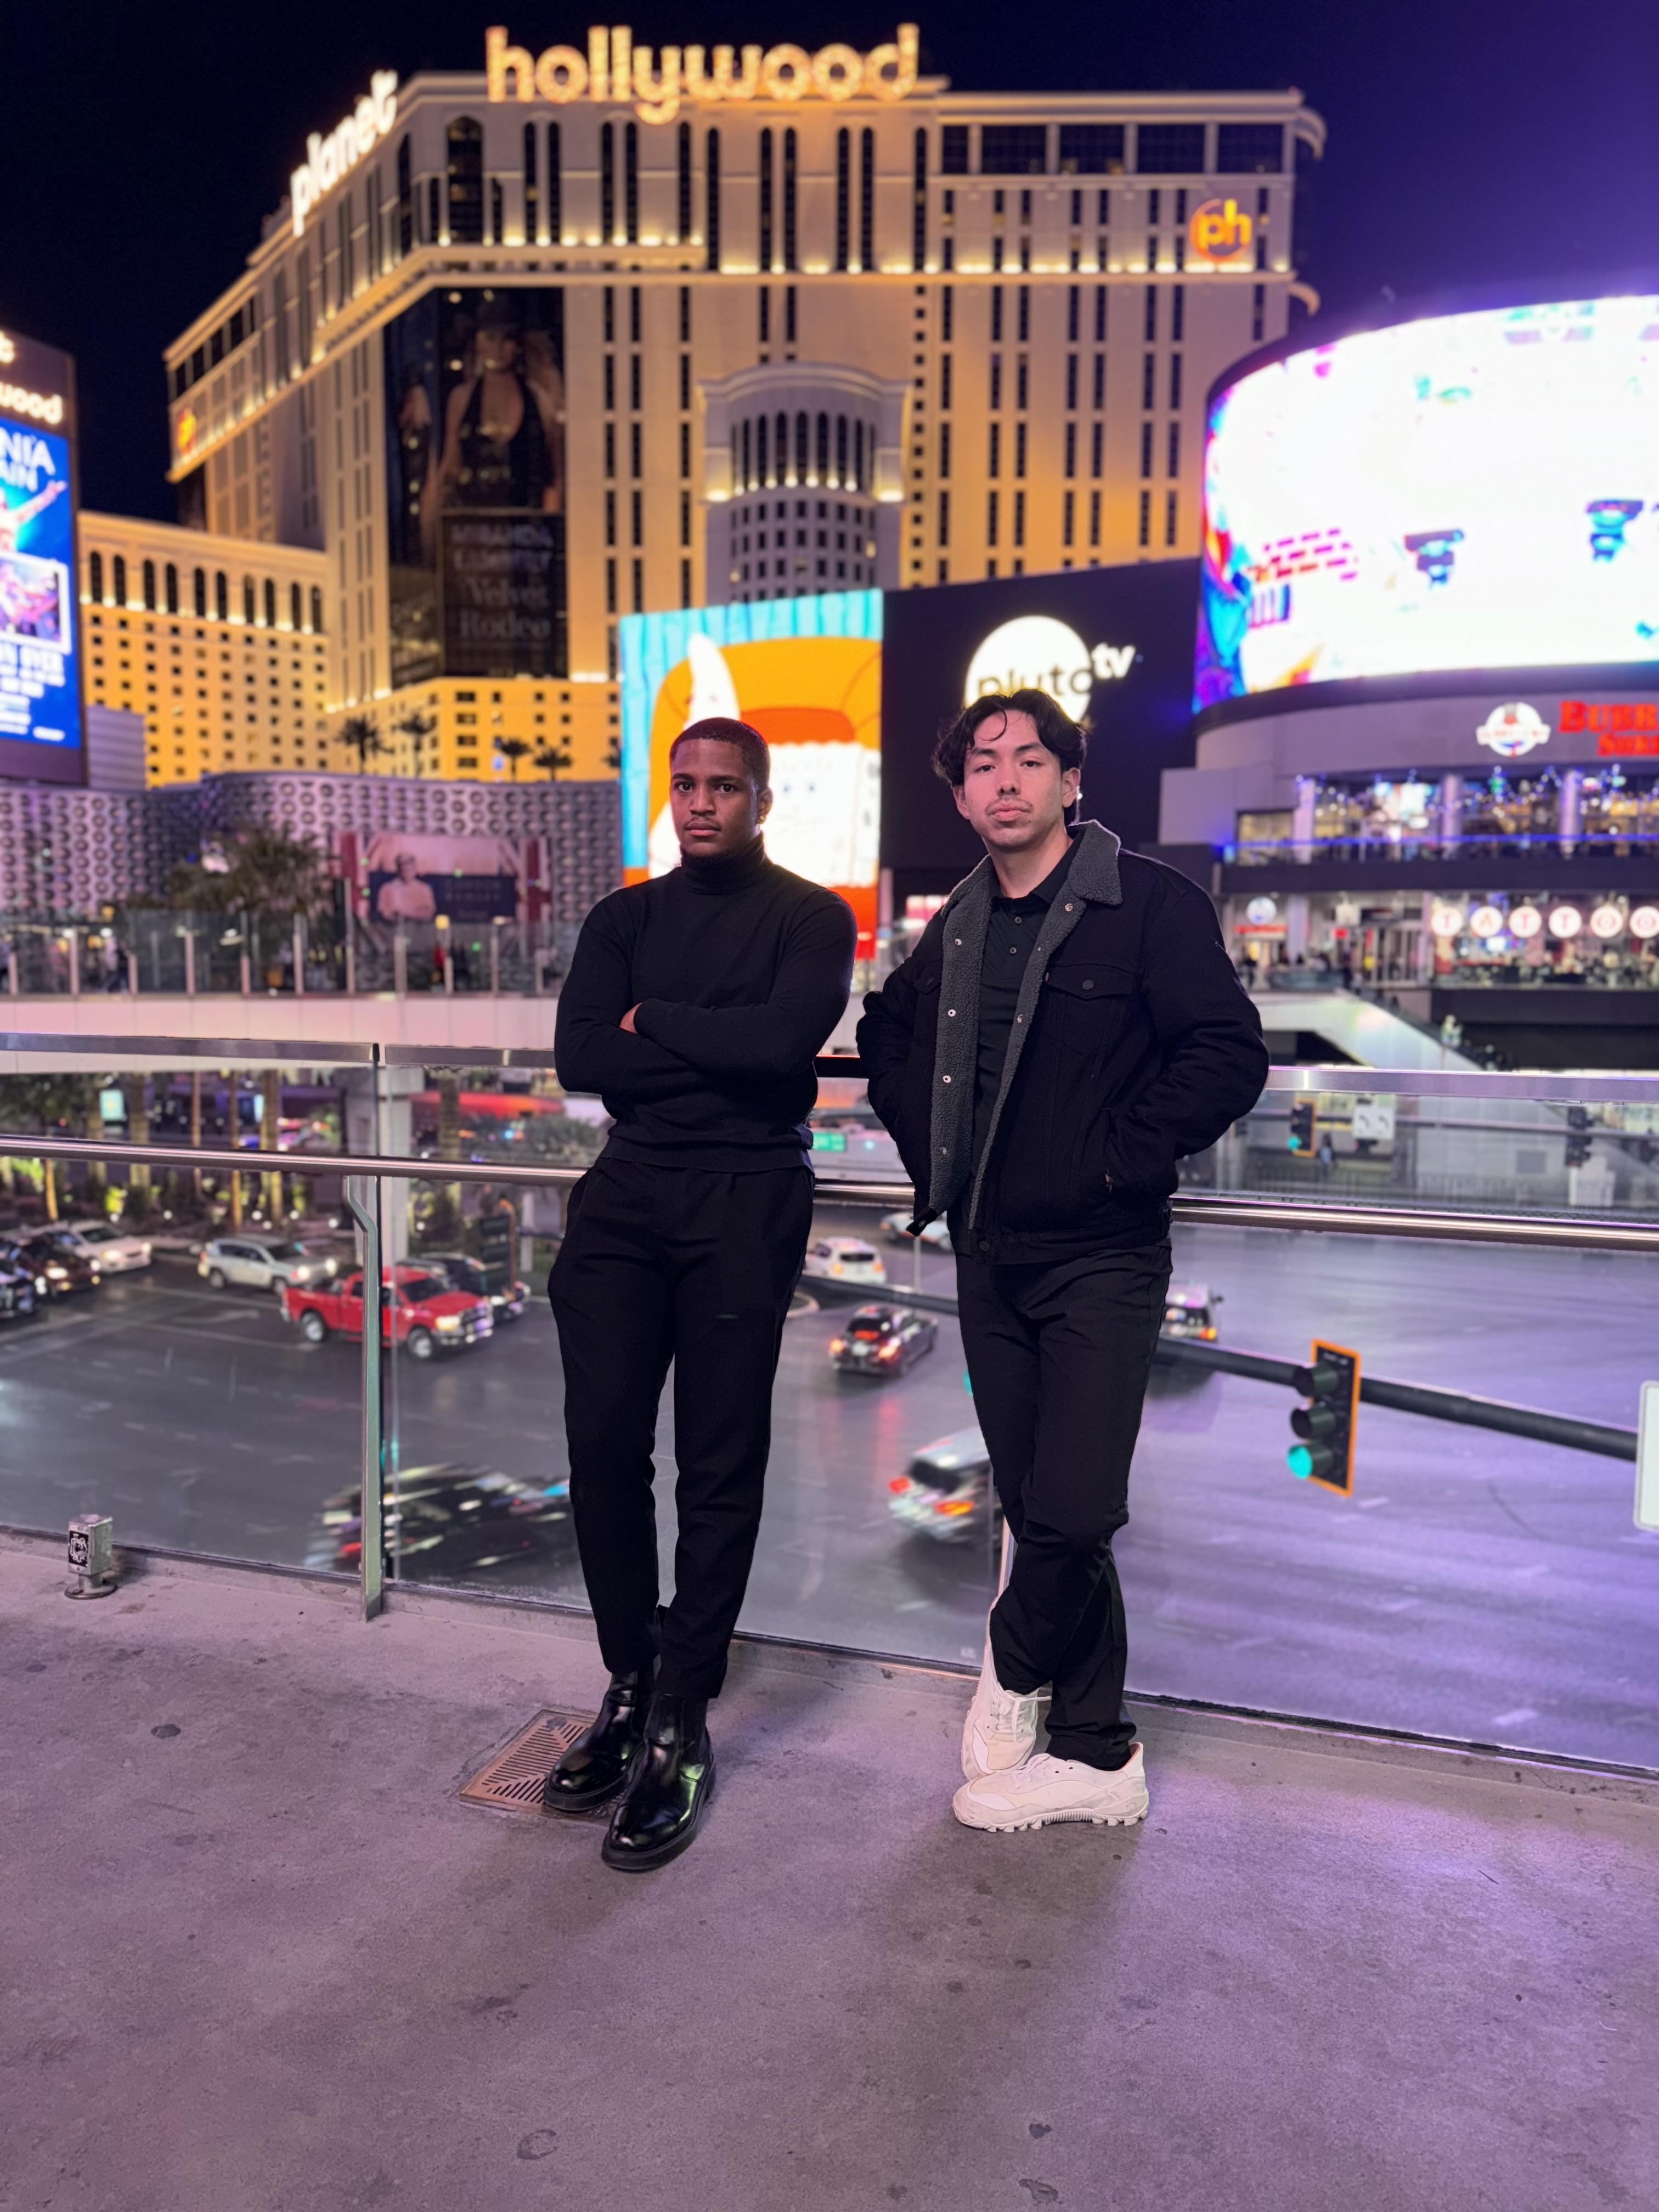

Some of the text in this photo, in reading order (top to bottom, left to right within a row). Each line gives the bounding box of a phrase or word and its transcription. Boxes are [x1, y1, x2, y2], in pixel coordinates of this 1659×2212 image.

[486, 23, 919, 125] hollywood
[290, 70, 398, 237] planet
[1196, 198, 1253, 253] ph
[1091, 642, 1136, 679] tv
[1558, 701, 1659, 733] BUBB
